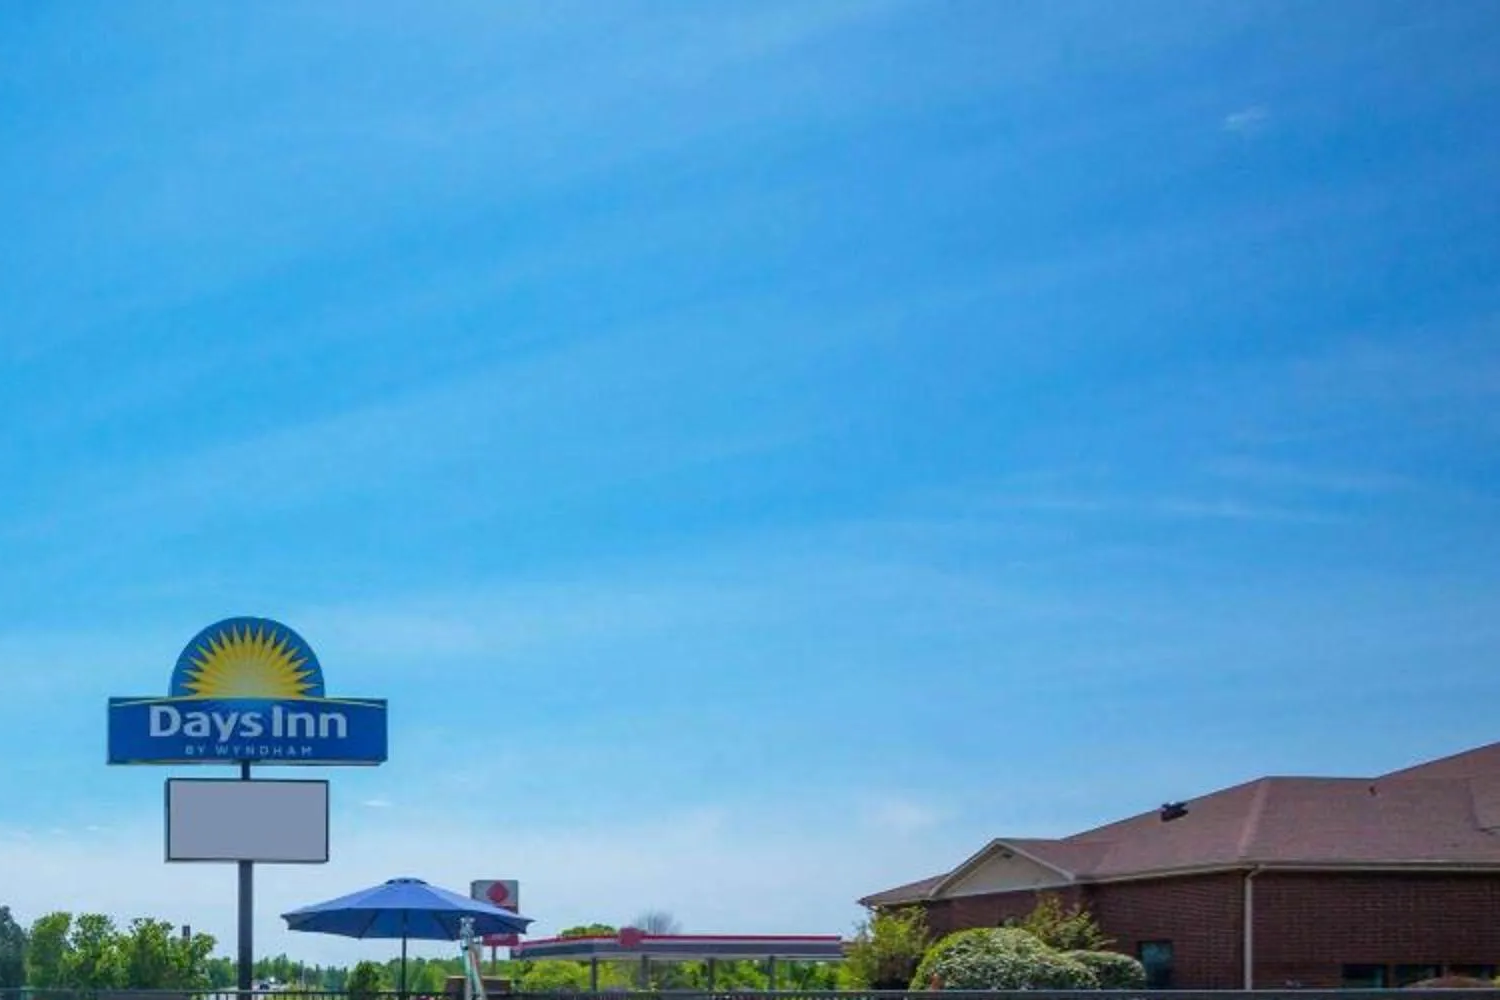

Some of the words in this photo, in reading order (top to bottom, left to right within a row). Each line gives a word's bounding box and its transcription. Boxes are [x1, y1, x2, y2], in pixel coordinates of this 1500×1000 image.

[149, 705, 263, 742] Days
[272, 706, 347, 738] Inn
[185, 745, 205, 755] BY
[215, 745, 313, 756] WYNDHAM
